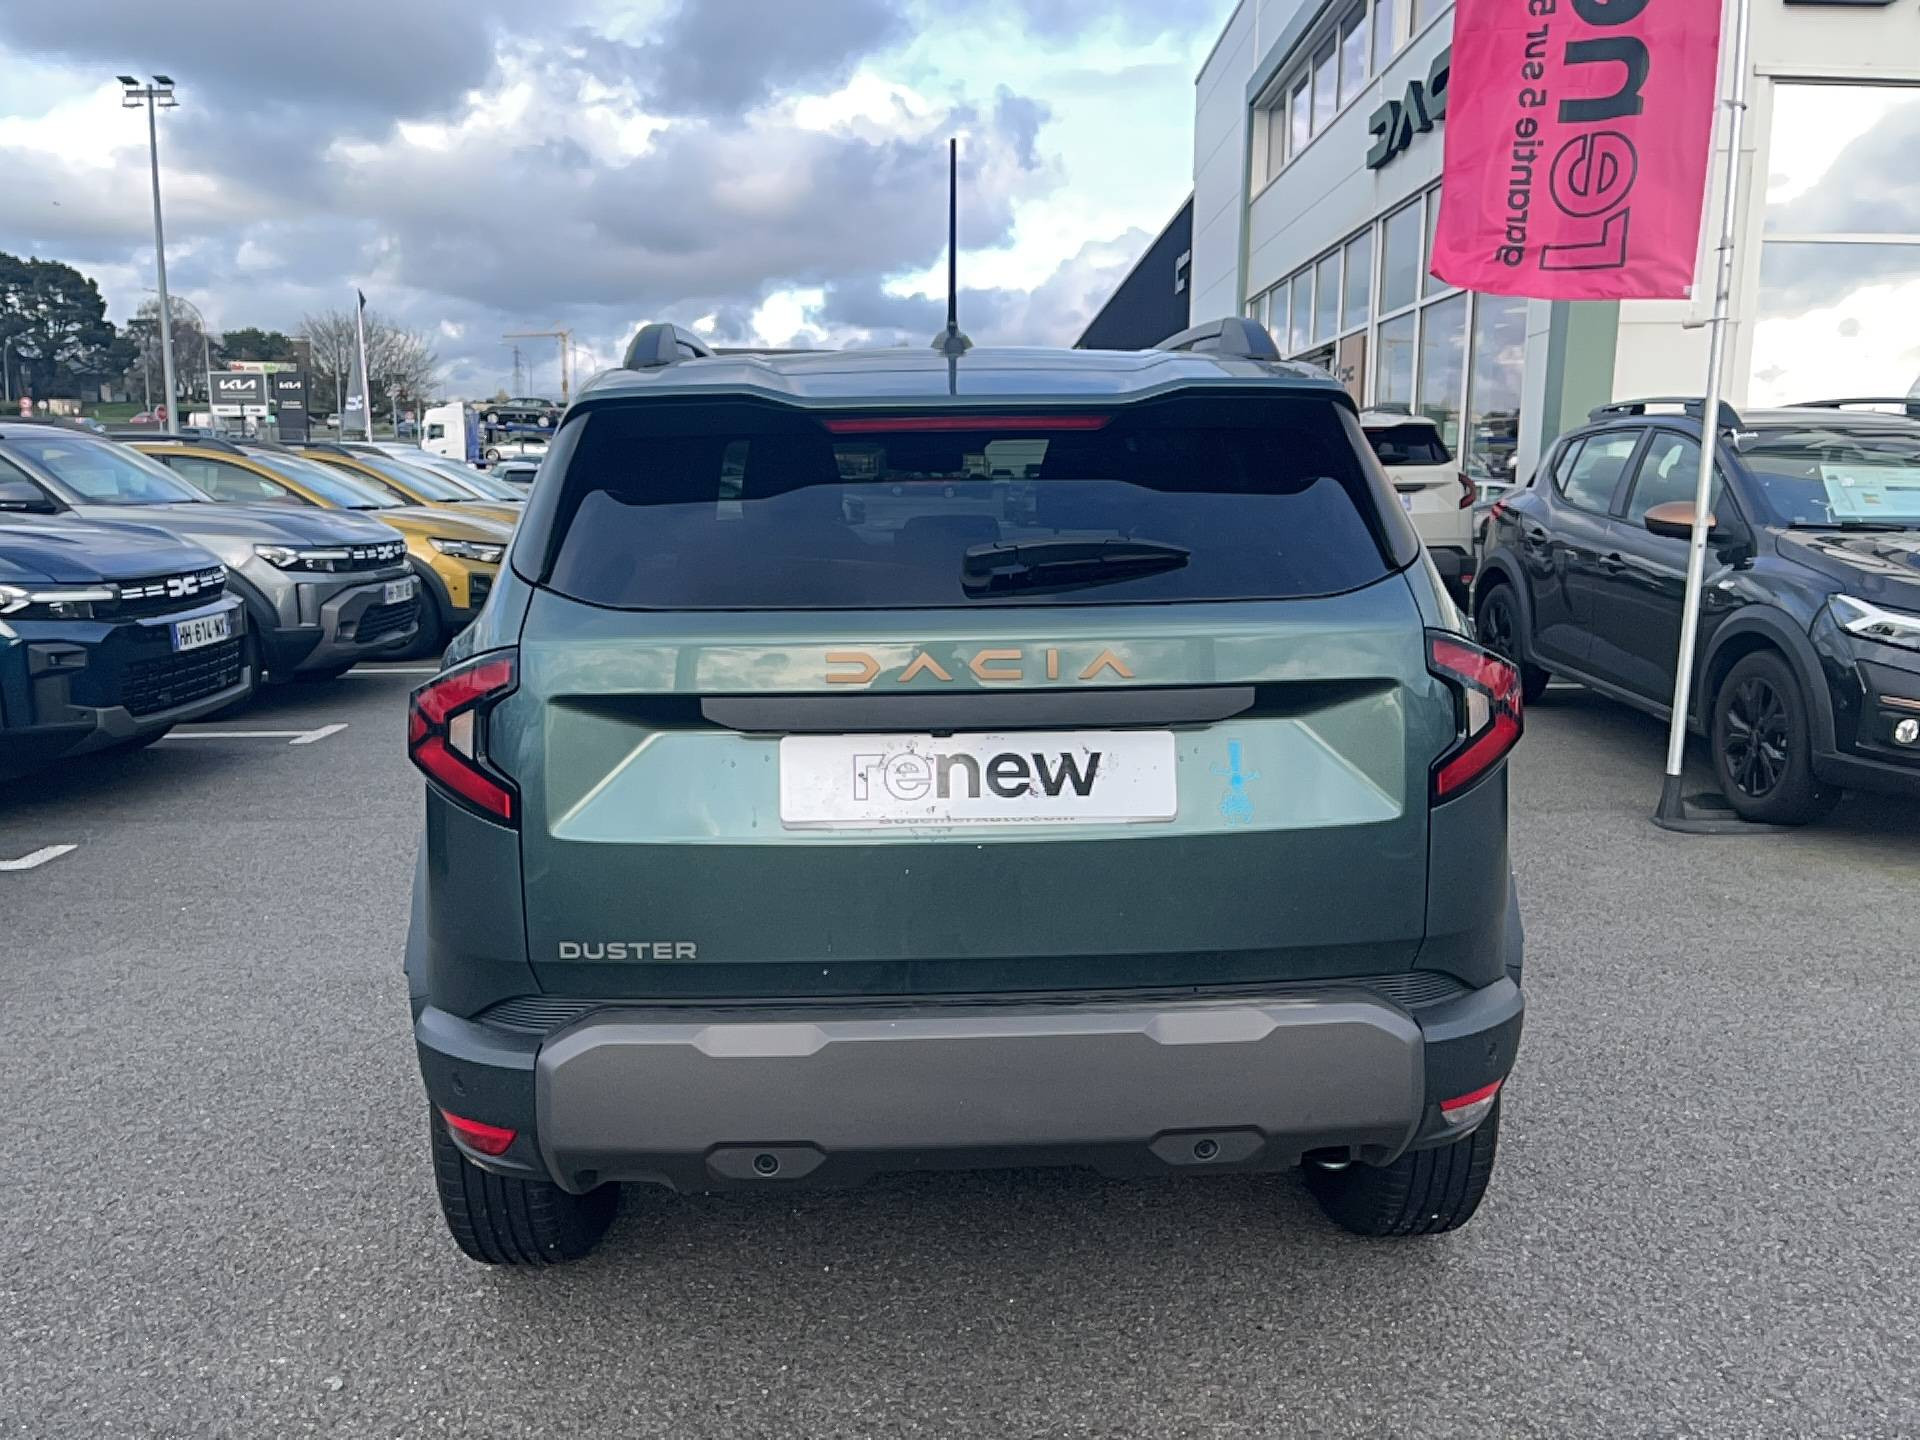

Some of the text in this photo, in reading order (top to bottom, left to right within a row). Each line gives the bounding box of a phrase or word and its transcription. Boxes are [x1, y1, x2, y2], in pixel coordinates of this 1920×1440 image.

[219, 379, 257, 390] KIA
[279, 381, 302, 390] KIA
[825, 649, 1136, 684] DACIA
[852, 751, 1102, 802] renew
[558, 940, 698, 961] DUSTER
